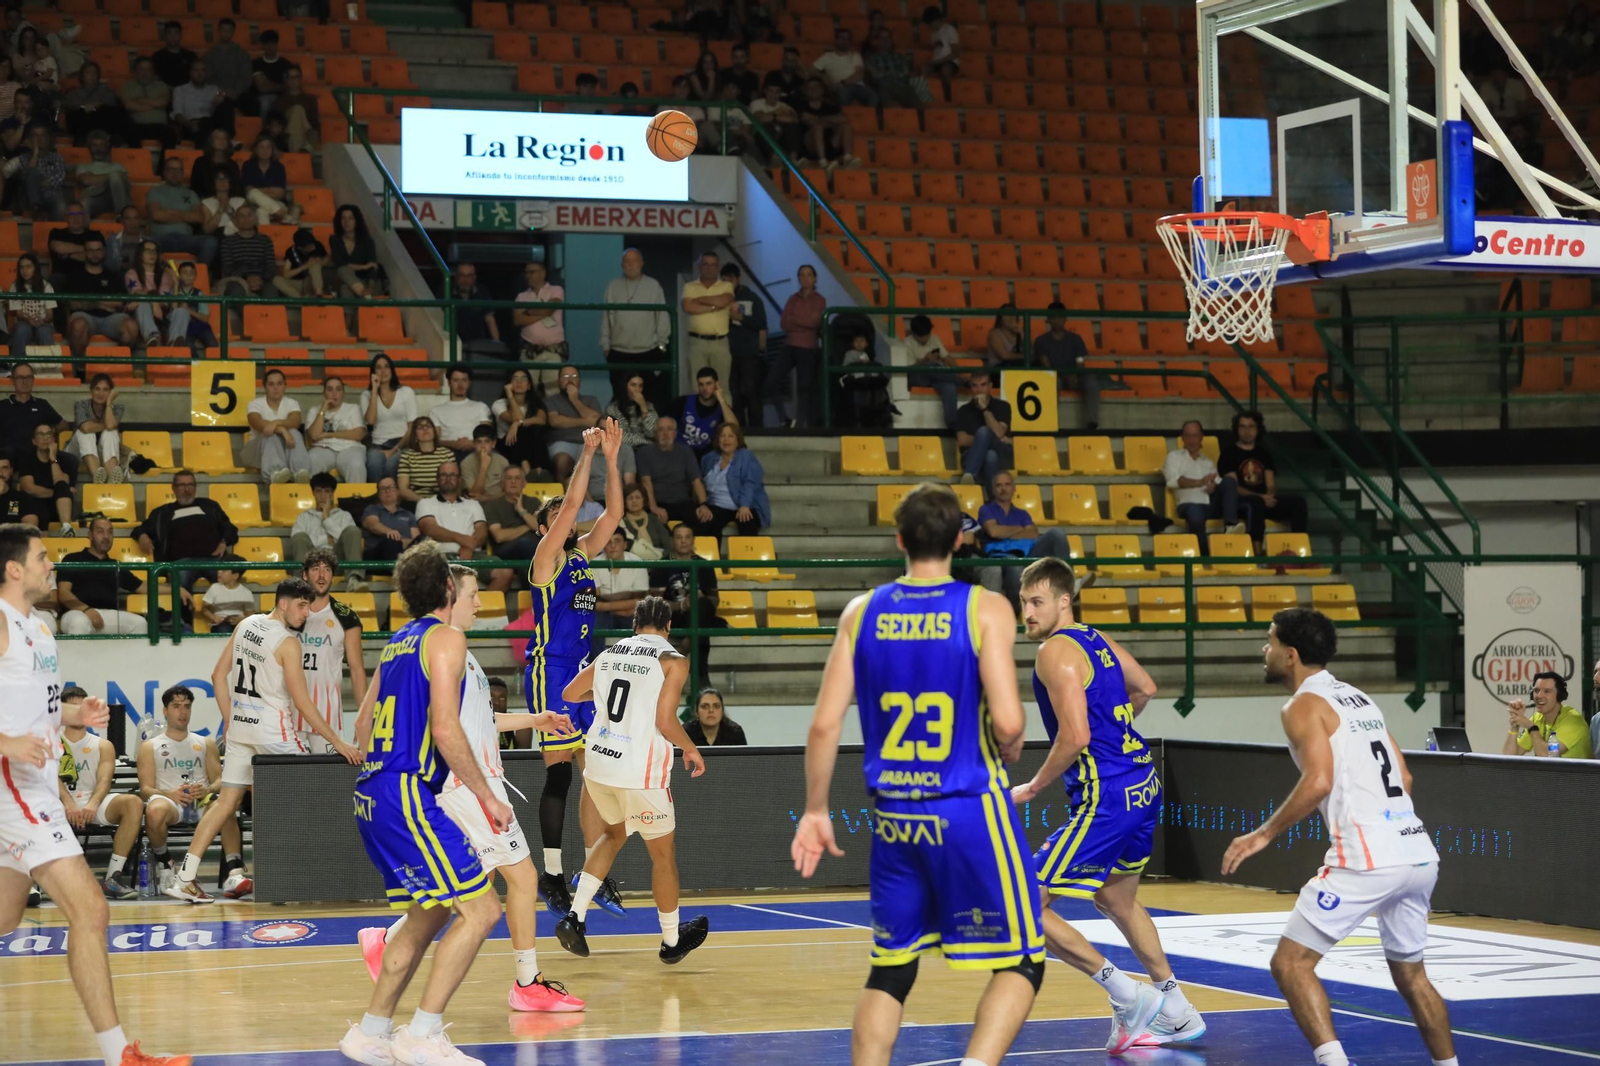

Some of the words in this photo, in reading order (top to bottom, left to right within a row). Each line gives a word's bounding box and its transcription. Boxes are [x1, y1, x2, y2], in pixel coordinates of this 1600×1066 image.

[463, 133, 506, 158] La
[465, 171, 501, 180] Afilando
[514, 172, 576, 182] inconformismo
[578, 175, 600, 183] desde
[603, 175, 624, 184] 1910
[556, 205, 720, 229] EMERXENCIA
[208, 372, 237, 415] 5
[1016, 381, 1042, 421] 6
[875, 612, 952, 640] SEIXAS
[303, 653, 318, 671] 21
[1492, 645, 1556, 657] ARROCERIA
[234, 658, 262, 699] 11
[623, 663, 651, 675] ENERGY
[1488, 659, 1557, 682] GIJON
[607, 678, 631, 723] 0
[233, 714, 260, 725] BILADU
[880, 691, 954, 762] 23
[1370, 740, 1403, 798] 2
